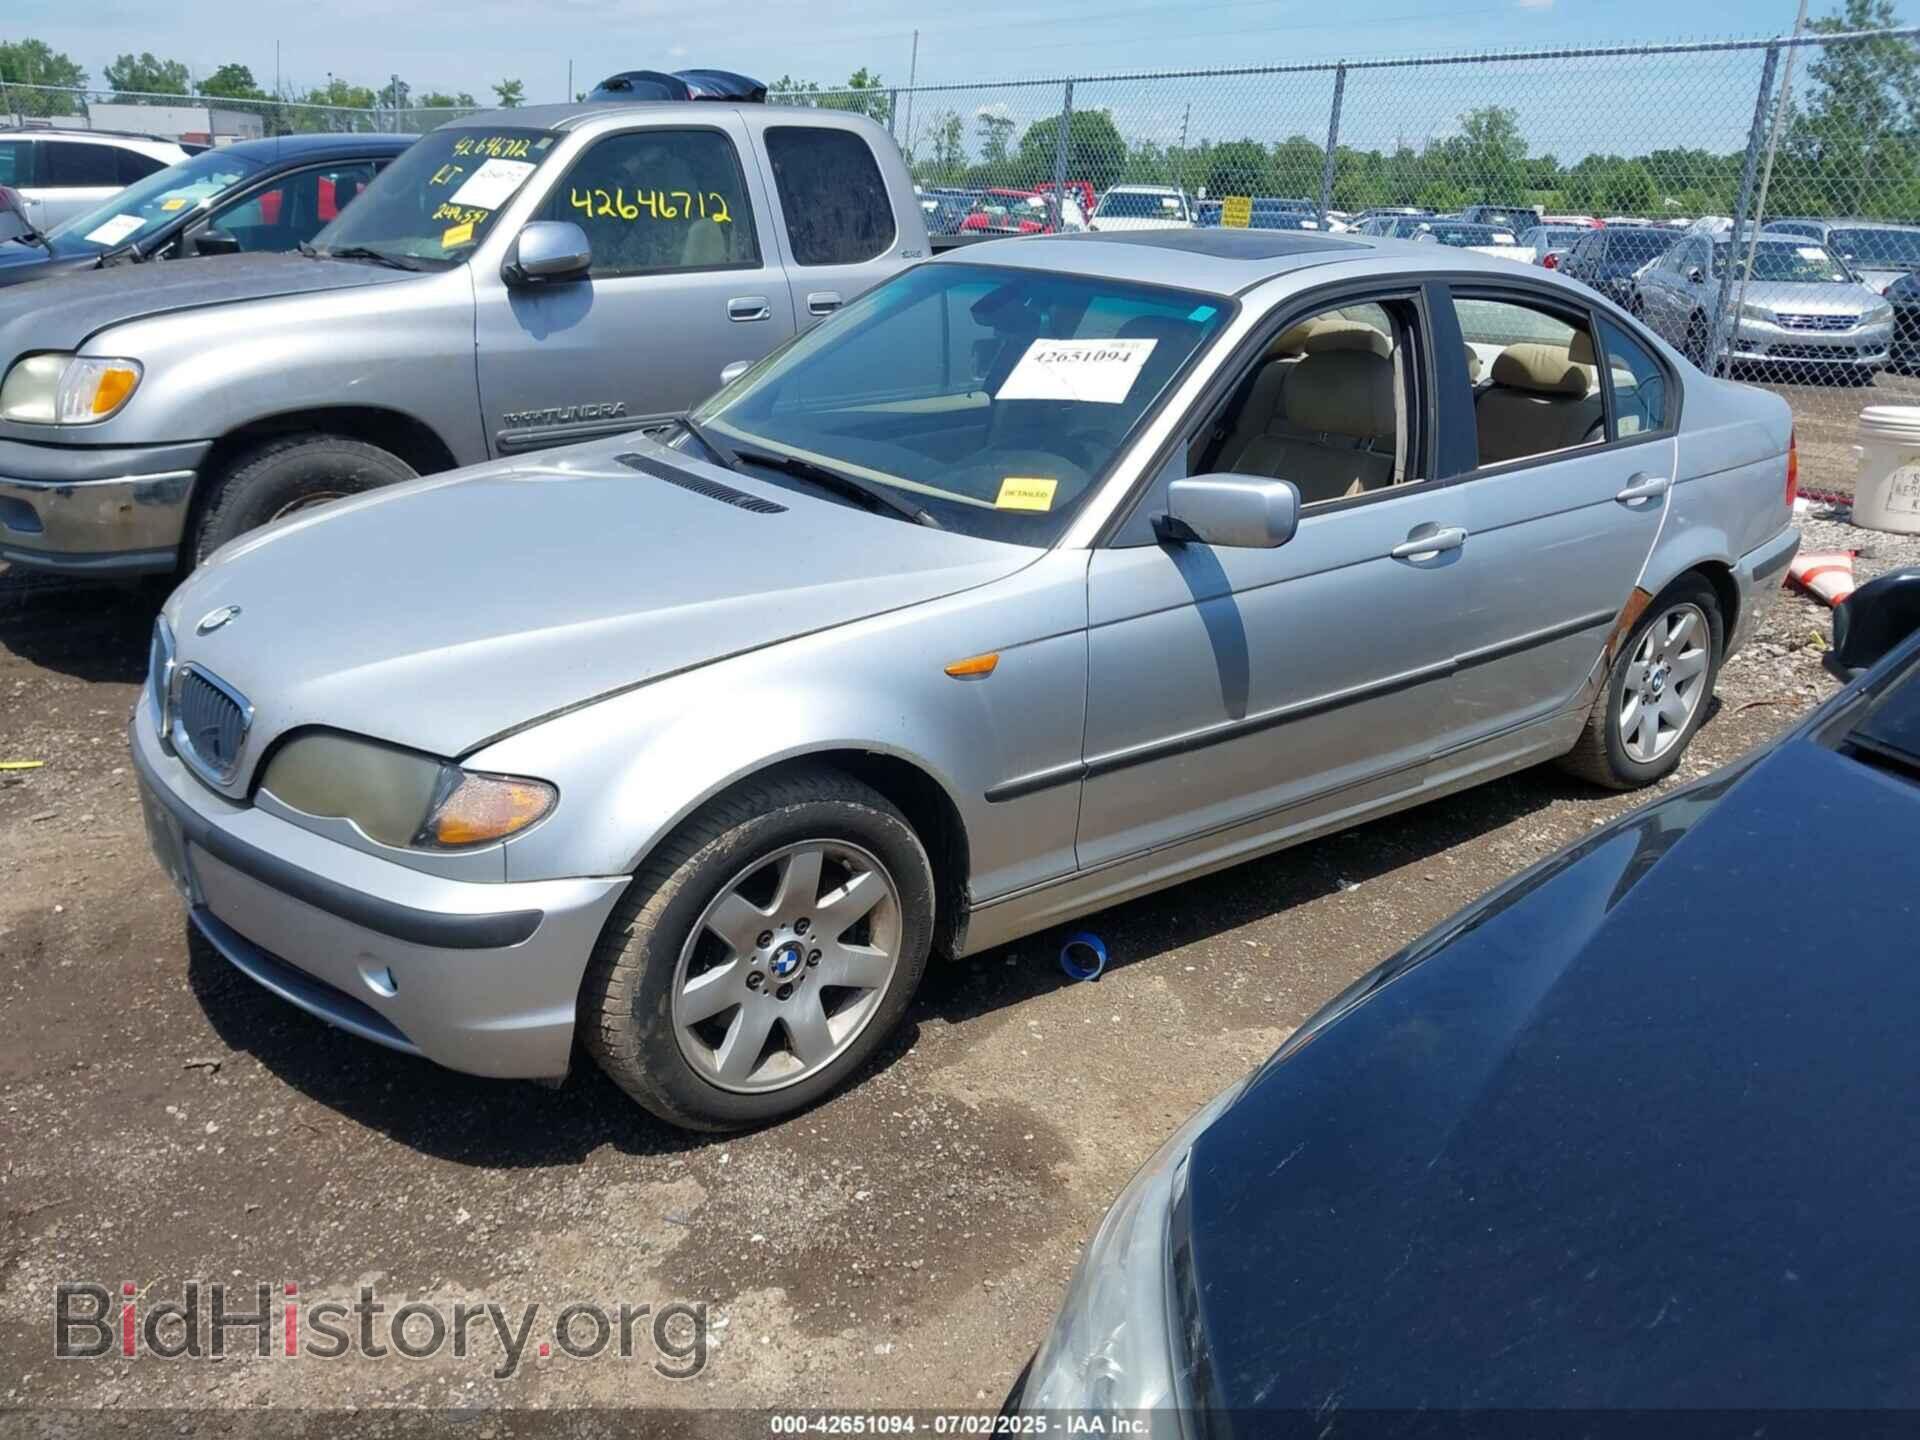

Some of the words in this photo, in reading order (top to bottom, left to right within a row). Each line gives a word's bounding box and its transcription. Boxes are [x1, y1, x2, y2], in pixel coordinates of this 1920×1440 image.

[571, 187, 732, 223] 42646712
[1033, 349, 1132, 363] 42651094
[543, 401, 625, 422] TUNDRA
